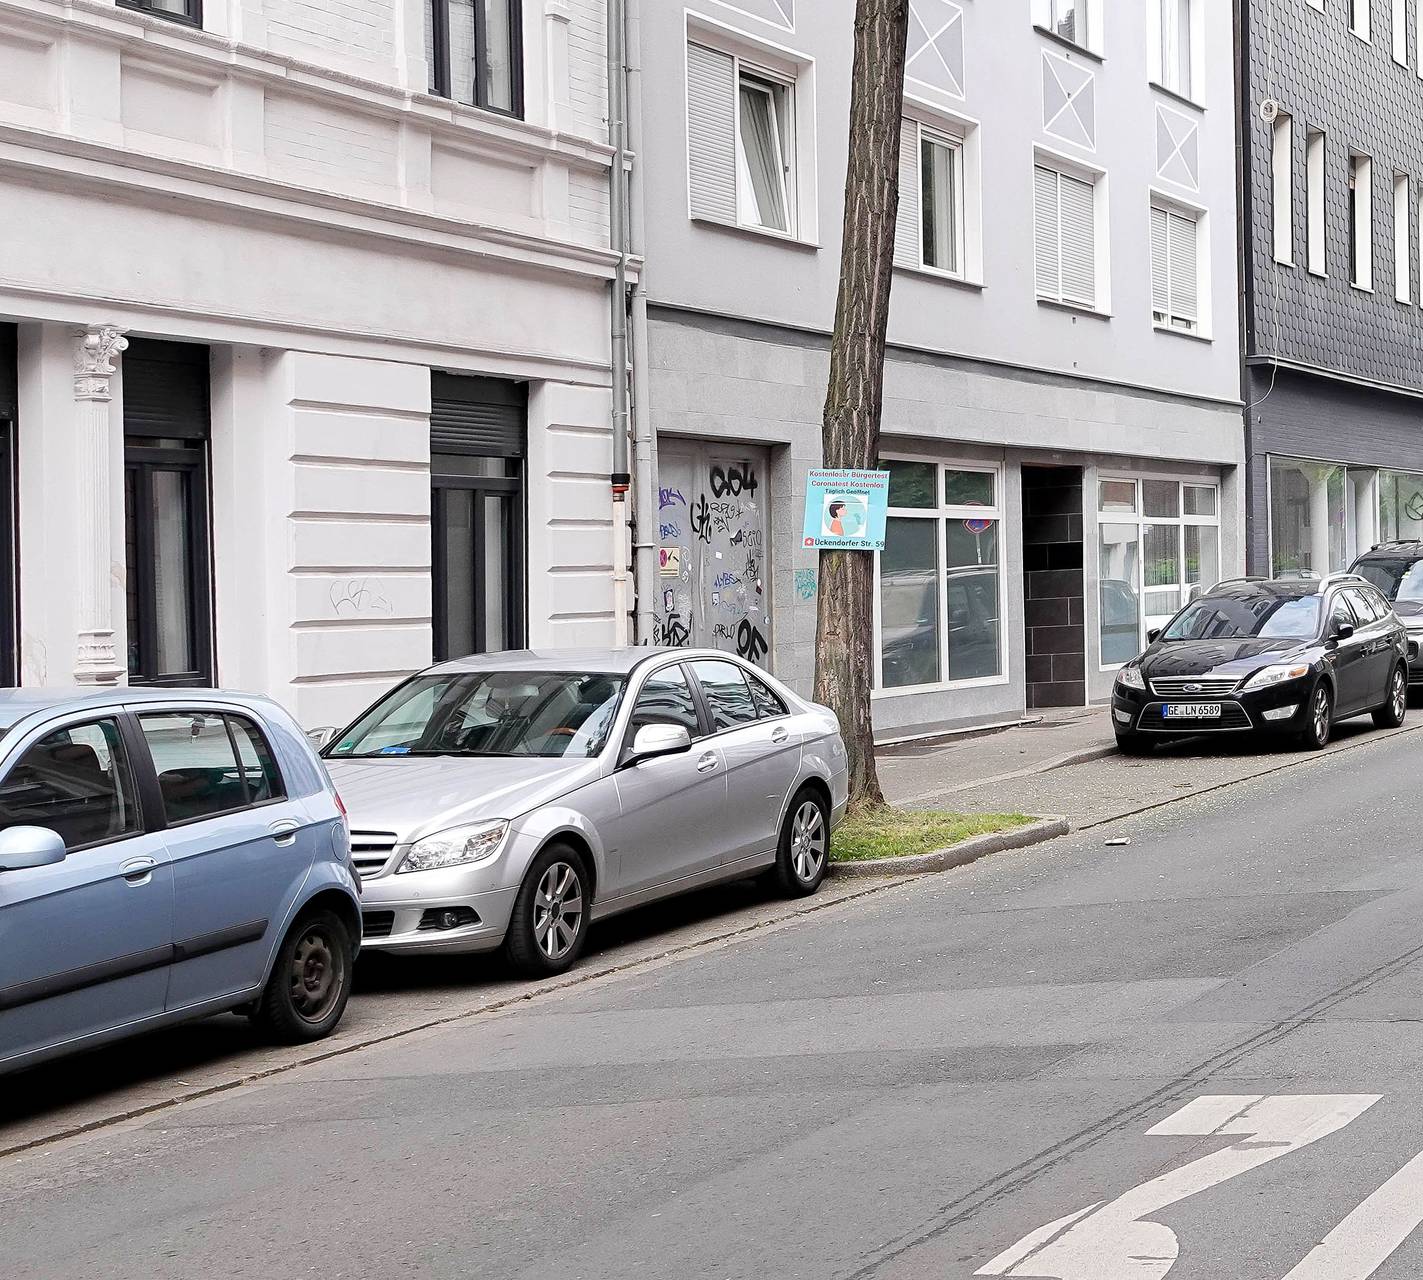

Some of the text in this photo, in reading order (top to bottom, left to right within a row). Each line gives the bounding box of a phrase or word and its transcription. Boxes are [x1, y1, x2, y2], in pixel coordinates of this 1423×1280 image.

[810, 470, 888, 479] Kostenloser Bürgertest
[815, 537, 859, 547] Ückendorfer
[1168, 705, 1220, 716] GE LN 6589
